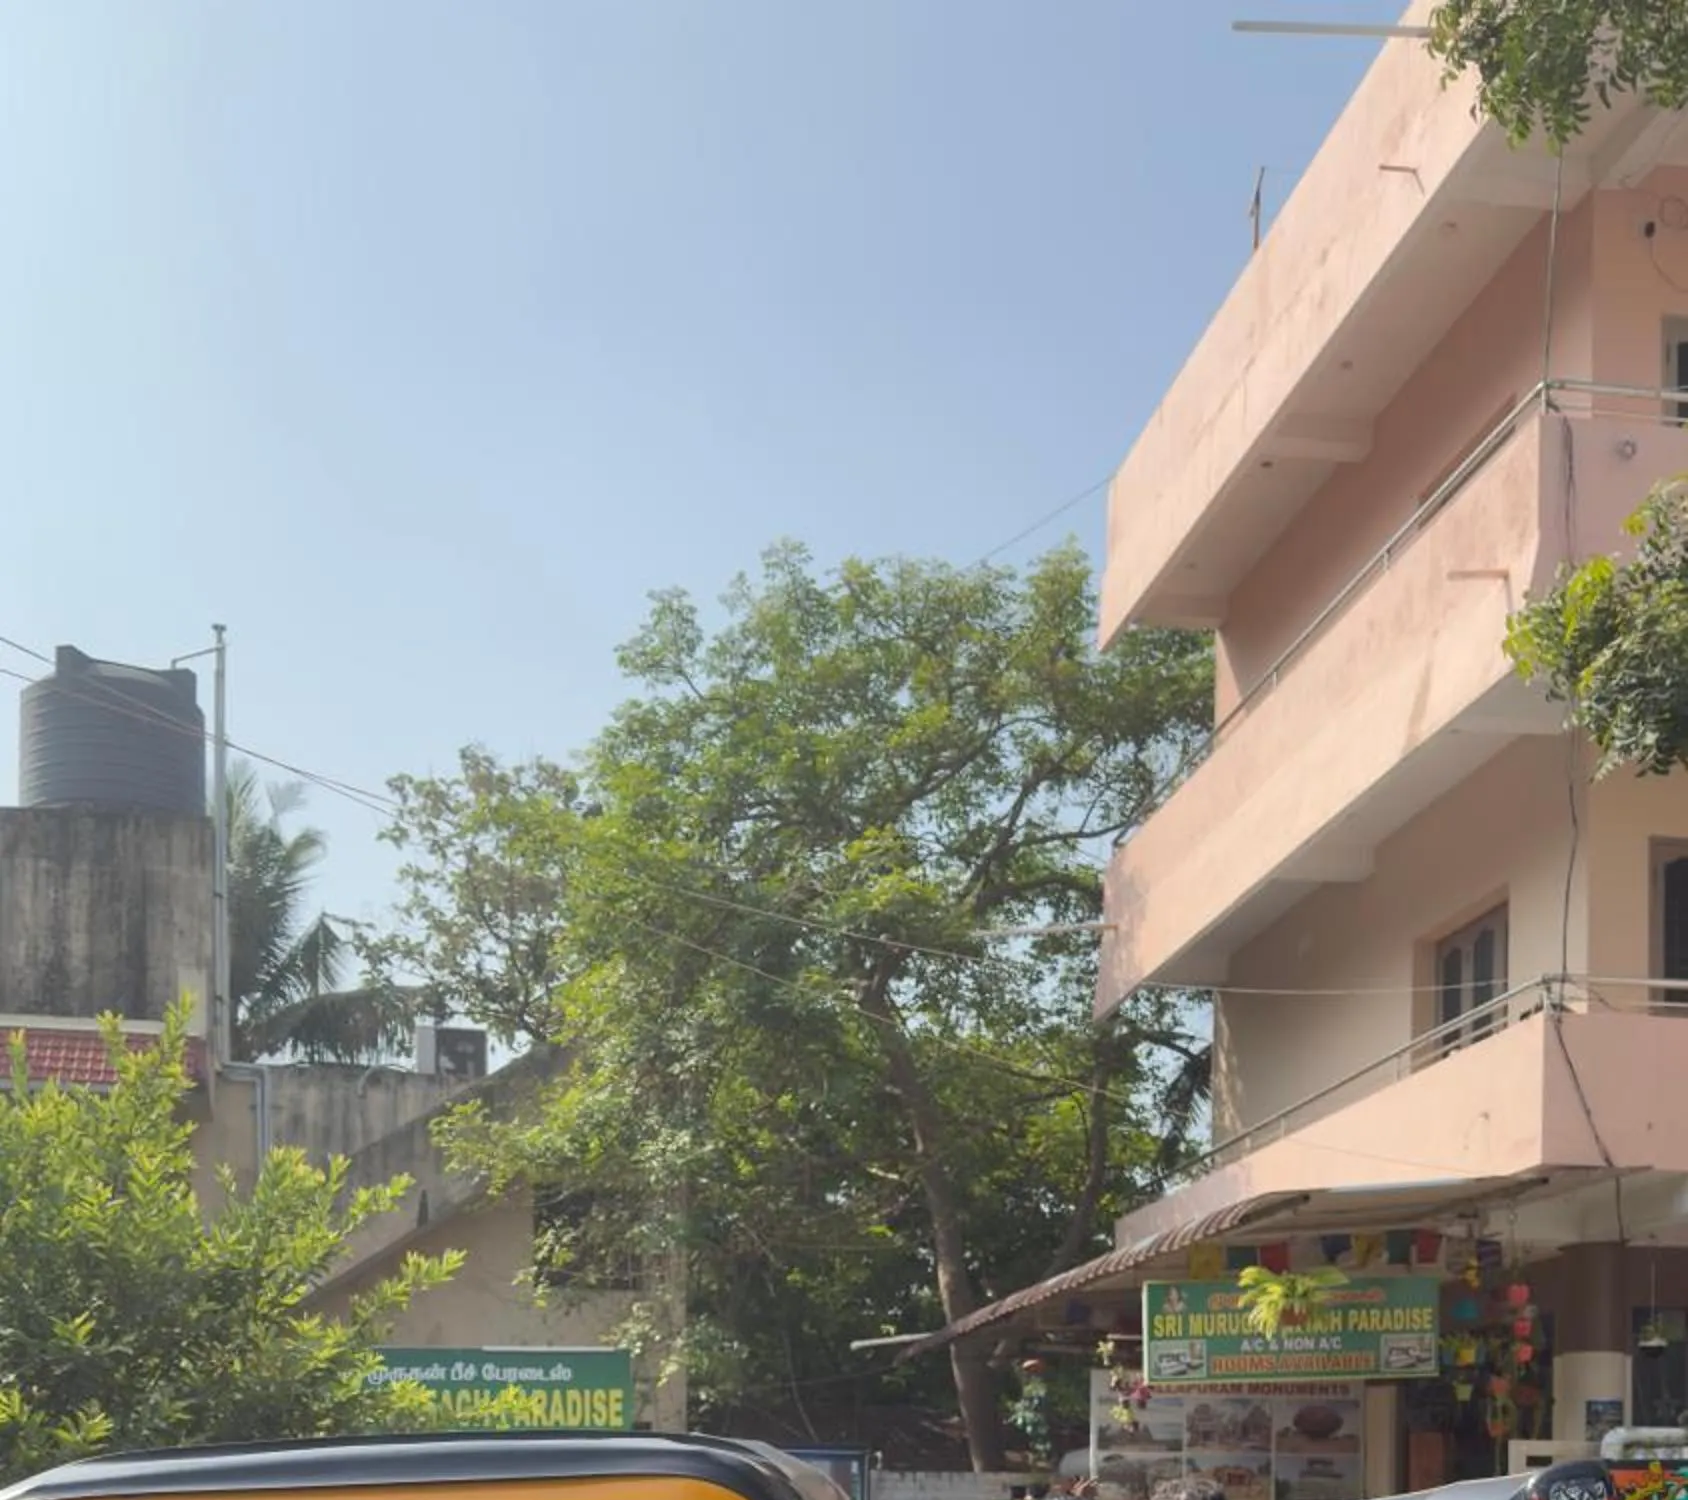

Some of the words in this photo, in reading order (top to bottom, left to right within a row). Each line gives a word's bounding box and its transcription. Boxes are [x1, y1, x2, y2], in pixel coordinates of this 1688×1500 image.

[1153, 1314, 1183, 1337] SRI
[1189, 1311, 1272, 1336] MURUG
[1347, 1306, 1433, 1331] PARADISE
[1283, 1336, 1315, 1350] NON
